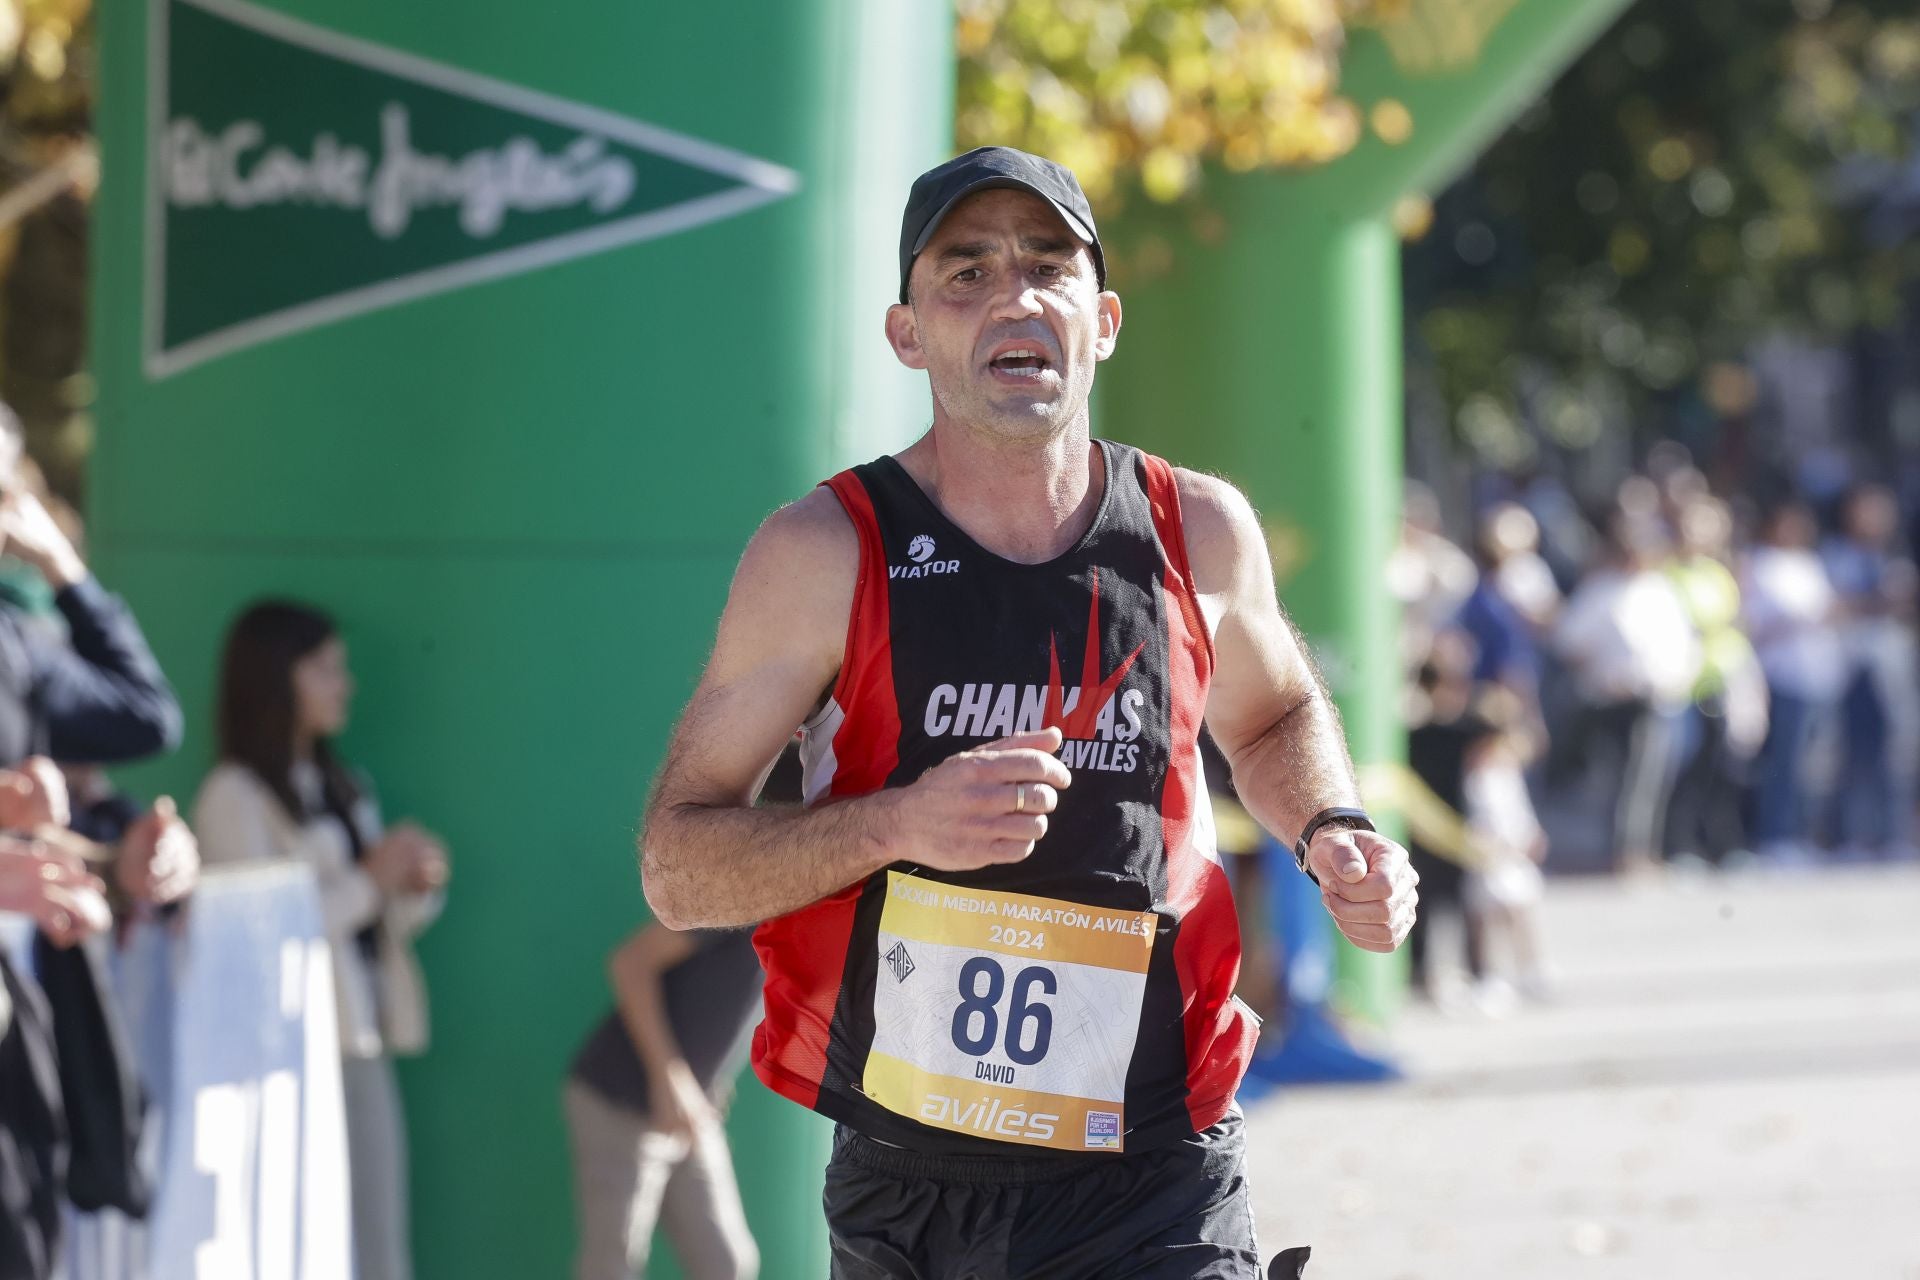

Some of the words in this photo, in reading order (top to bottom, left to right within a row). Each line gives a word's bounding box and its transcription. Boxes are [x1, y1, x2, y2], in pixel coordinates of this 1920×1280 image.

[888, 559, 960, 580] VIATOR
[943, 894, 998, 916] MEDIA
[1001, 902, 1091, 929] MARATÓN
[1092, 915, 1151, 937] AVILÉS
[989, 925, 1045, 951] 2024
[951, 956, 1058, 1066] 86
[975, 1060, 1016, 1085] DAVID
[919, 1093, 1060, 1140] avilés
